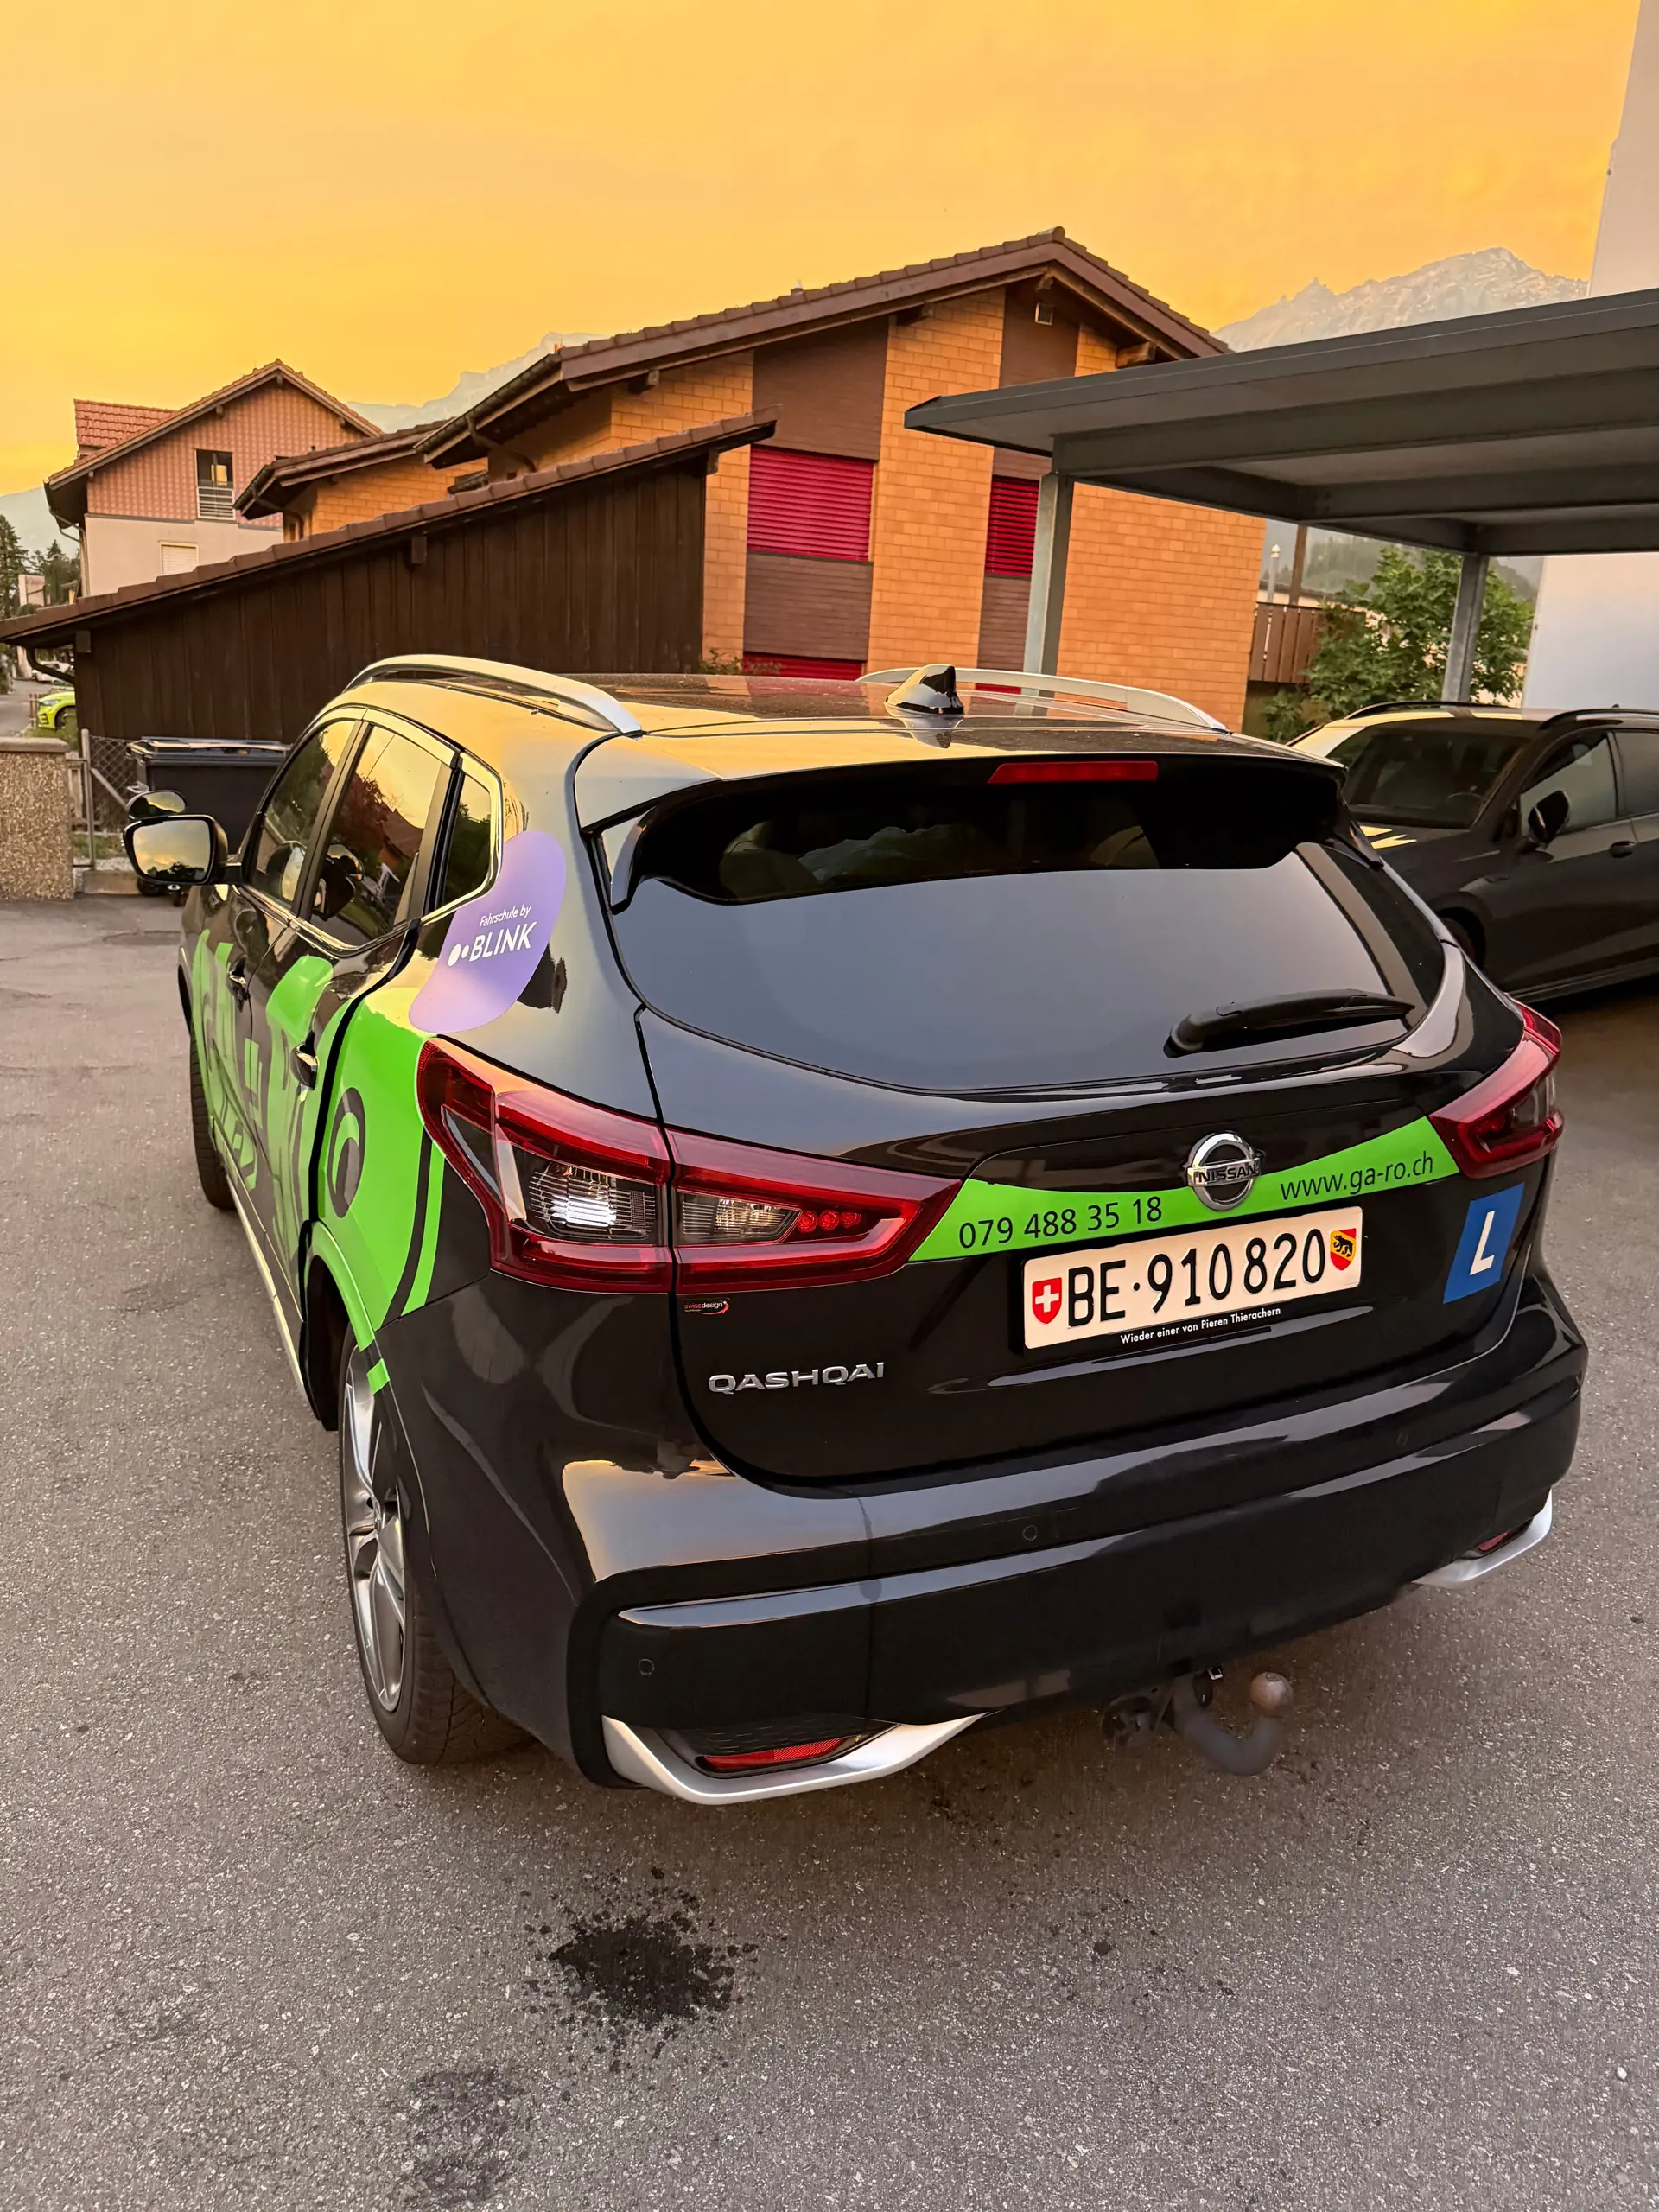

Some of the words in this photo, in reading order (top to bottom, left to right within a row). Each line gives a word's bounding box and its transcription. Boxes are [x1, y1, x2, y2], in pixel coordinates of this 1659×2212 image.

[479, 906, 519, 928] Fahrschule
[519, 904, 531, 919] by
[469, 921, 537, 962] BLINK
[1198, 1162, 1256, 1183] NISSAN
[1280, 1150, 1433, 1201] www.ga-ro.ch
[958, 1217, 1014, 1249] 079
[1023, 1208, 1077, 1239] 488
[1087, 1201, 1120, 1231] 35
[1132, 1196, 1162, 1224] 18
[1469, 1210, 1496, 1276] L
[1120, 1332, 1154, 1344] Wieder
[1157, 1327, 1180, 1338] einer
[1182, 1324, 1198, 1332] von
[1201, 1318, 1229, 1330] Pieren
[1230, 1307, 1281, 1324] Thierachern
[709, 1362, 885, 1395] QASHQAI
